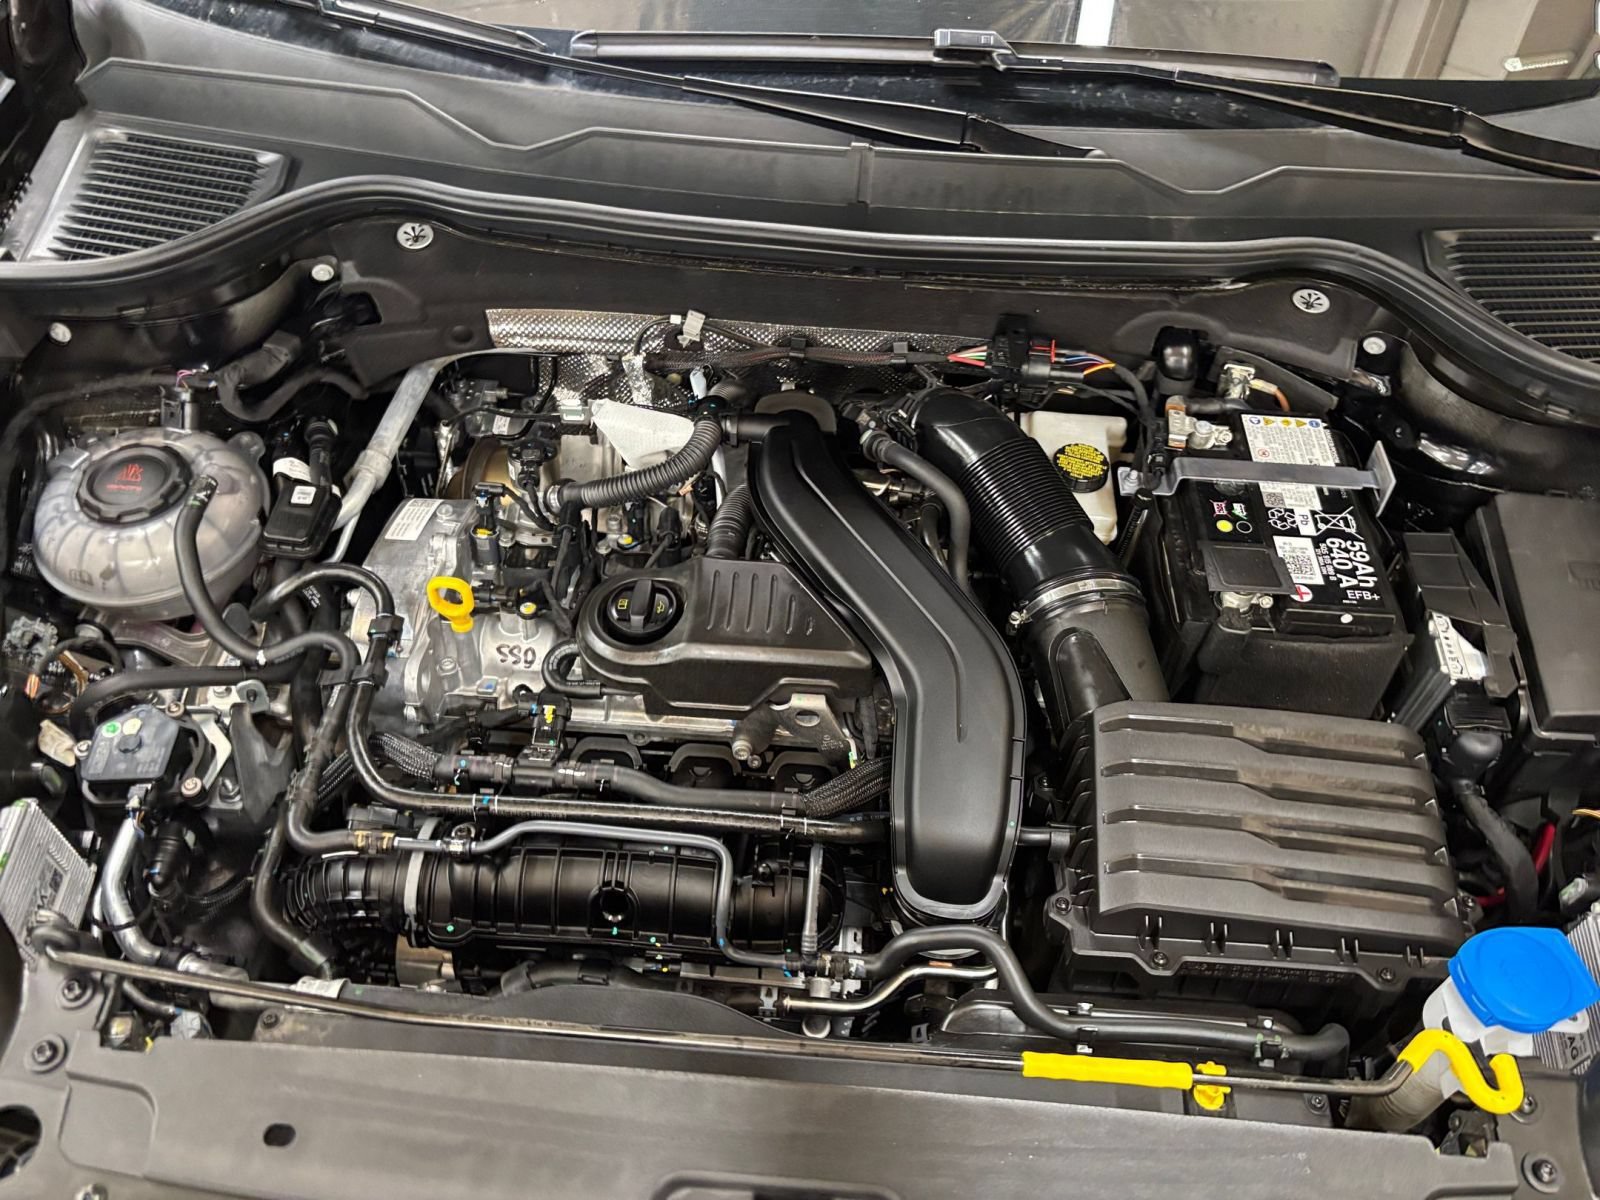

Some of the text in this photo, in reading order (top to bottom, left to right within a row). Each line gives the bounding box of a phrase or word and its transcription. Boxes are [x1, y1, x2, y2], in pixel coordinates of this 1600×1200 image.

[1298, 514, 1310, 526] Pb
[1325, 537, 1353, 570] 640
[1345, 540, 1378, 588] 59Ah
[1336, 573, 1359, 588] A
[1346, 589, 1380, 600] EFB+
